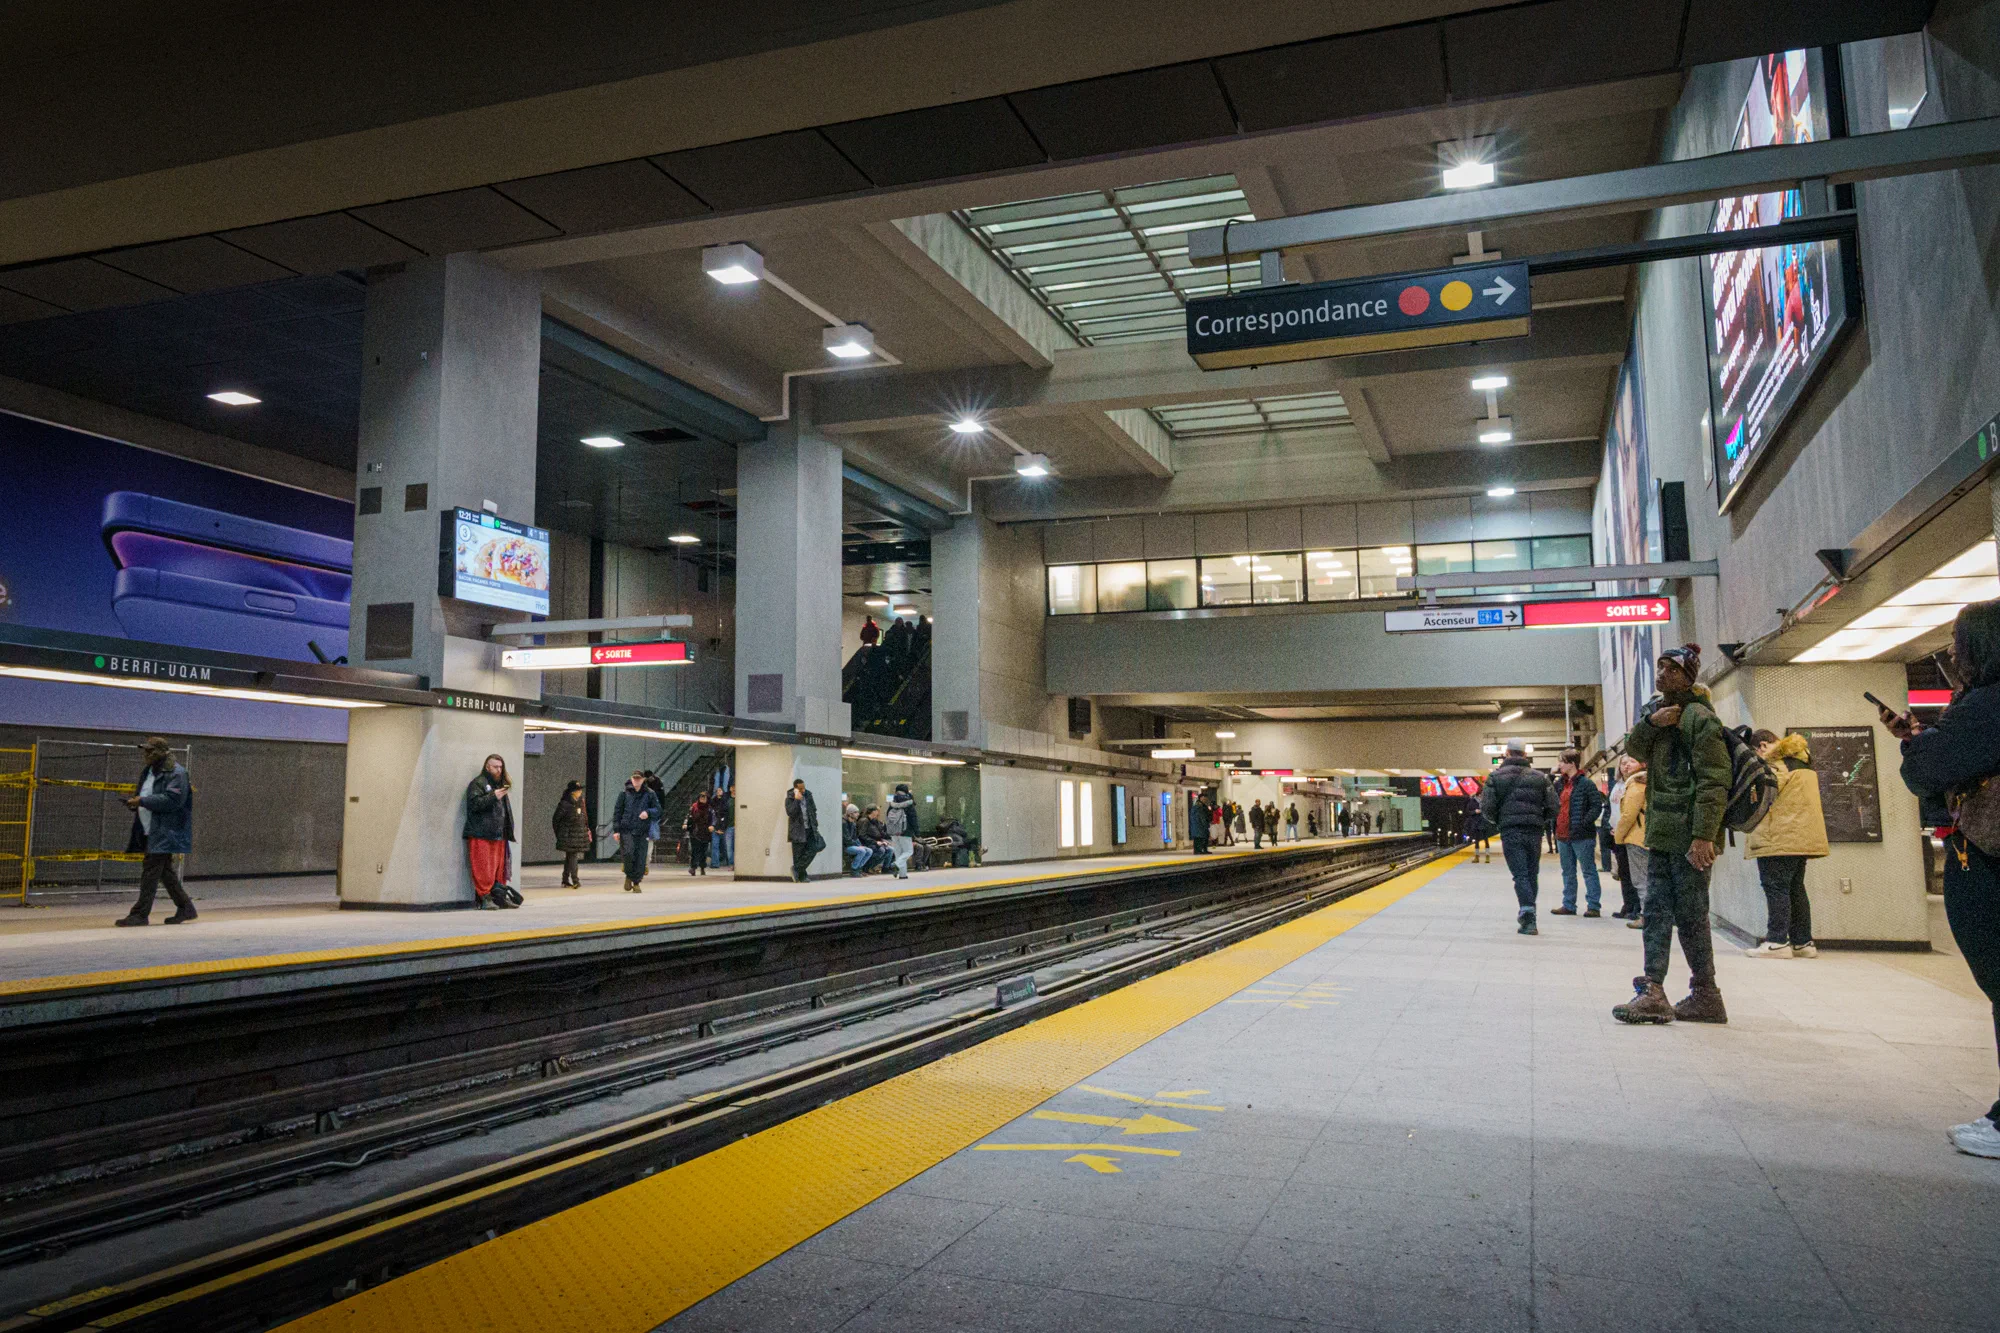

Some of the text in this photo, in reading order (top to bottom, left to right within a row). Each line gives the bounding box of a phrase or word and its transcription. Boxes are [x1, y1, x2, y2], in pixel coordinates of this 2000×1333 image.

[1195, 299, 1388, 336] Correspondance
[1606, 605, 1648, 617] SORTIE
[1424, 612, 1500, 626] Ascenseur 4
[605, 649, 632, 659] SORTIE
[110, 657, 211, 680] BERRI-UQAM
[455, 696, 515, 713] BERRI-UQAM
[666, 721, 706, 734] BERRI-UQAM
[1811, 730, 1870, 739] Honoré-Beaugrand
